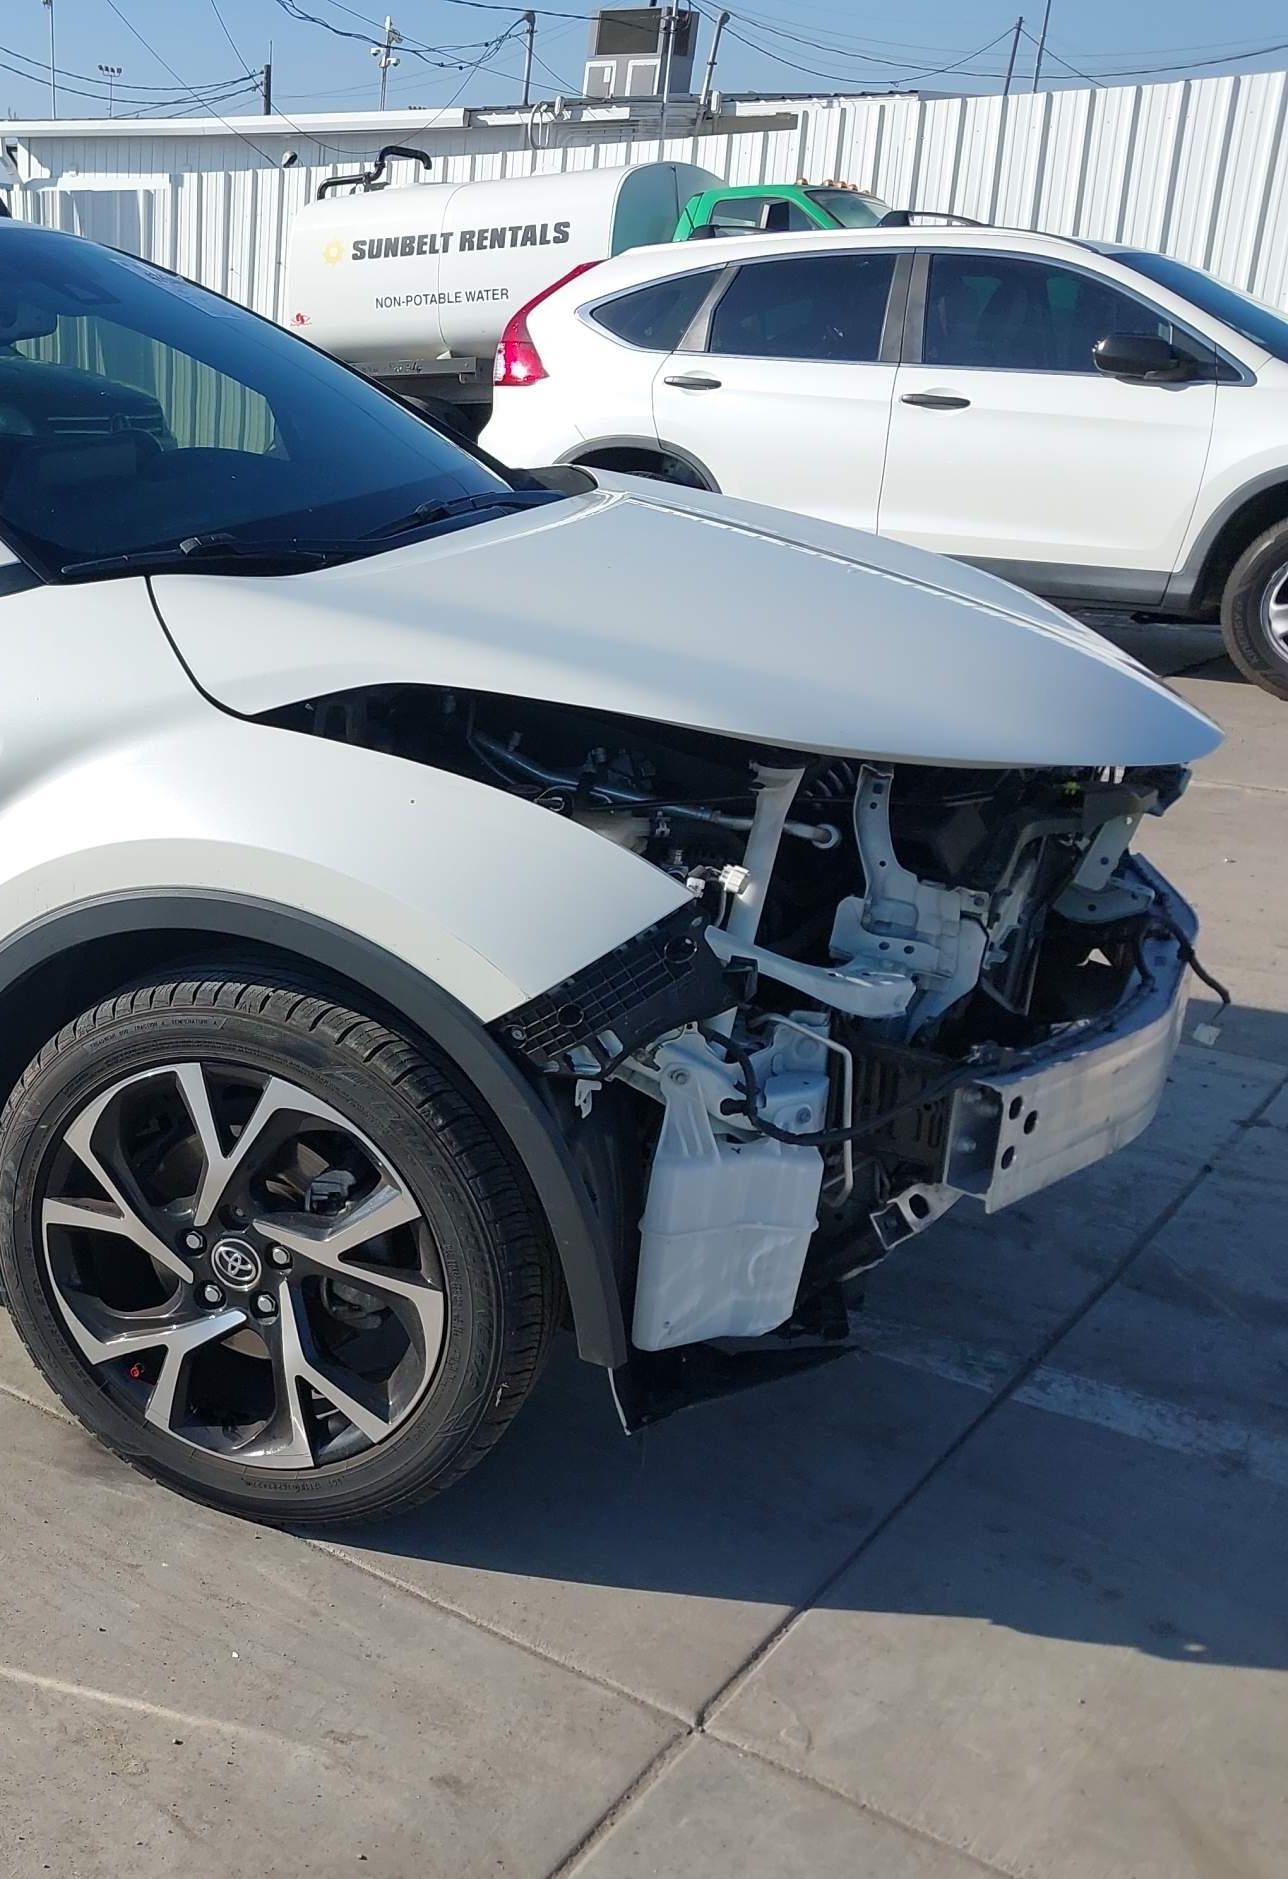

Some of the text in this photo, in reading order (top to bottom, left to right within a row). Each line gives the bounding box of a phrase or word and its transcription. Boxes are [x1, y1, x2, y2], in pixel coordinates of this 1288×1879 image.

[351, 221, 571, 261] SUNBELT RENTALS
[375, 288, 509, 309] NON-POTABLE WATER
